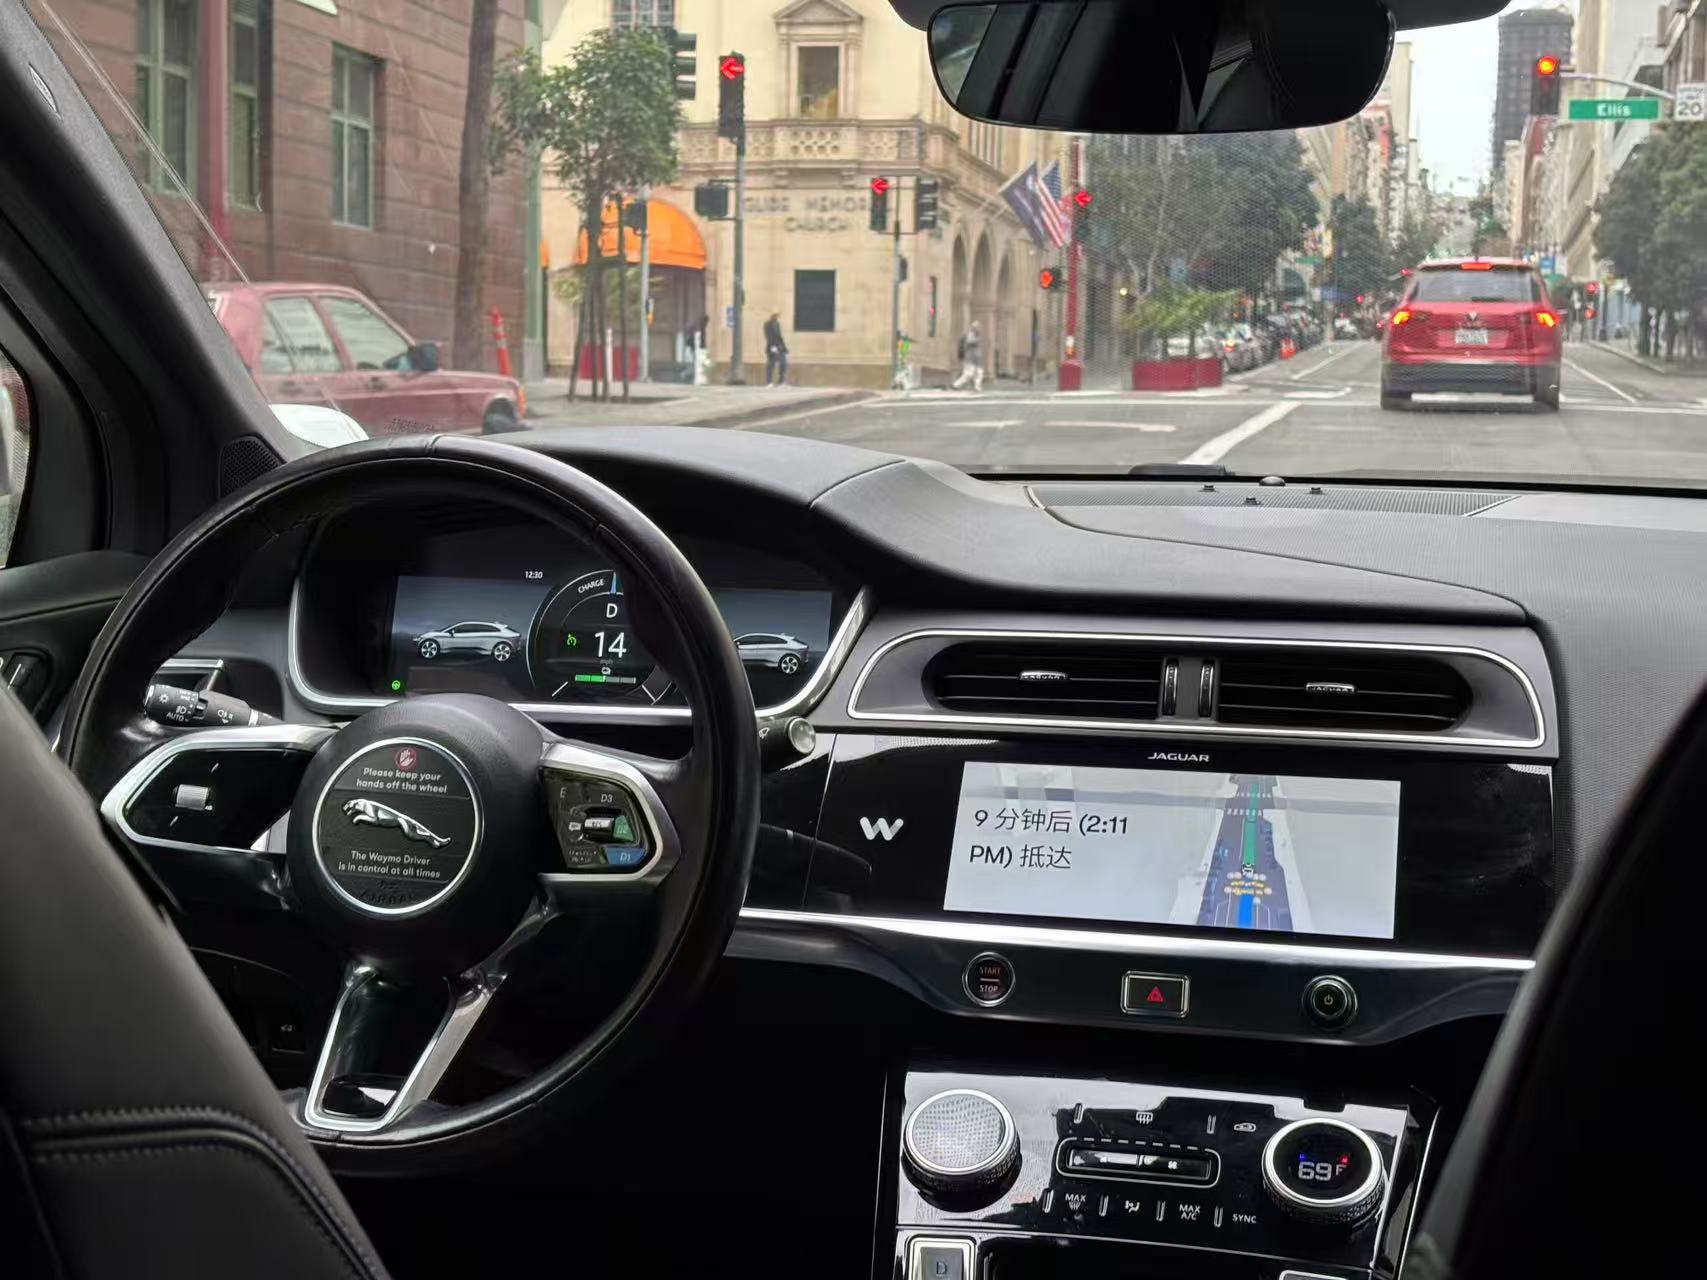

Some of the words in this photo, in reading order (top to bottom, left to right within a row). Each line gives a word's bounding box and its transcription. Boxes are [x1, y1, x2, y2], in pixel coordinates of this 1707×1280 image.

[1597, 103, 1631, 117] Ellis
[1678, 101, 1703, 116] 20
[525, 571, 543, 579] 12:30
[577, 578, 605, 593] CHARGE
[606, 603, 618, 618] D
[595, 631, 627, 659] 14
[166, 712, 185, 722] AUTO
[1147, 751, 1210, 763] JAGUAR
[363, 767, 394, 777] Please
[395, 770, 418, 780] keep
[419, 773, 441, 781] your
[356, 778, 384, 789] hands
[386, 780, 400, 789] off
[402, 782, 417, 791] the
[419, 783, 448, 793] wheel
[560, 787, 567, 798] E
[600, 794, 614, 803] D3
[975, 809, 989, 827] 9
[994, 807, 1073, 833] 分钟后
[1079, 815, 1128, 836] (2:11
[351, 850, 367, 860] The
[368, 852, 402, 864] Waymo
[403, 855, 430, 865] Driver
[620, 852, 631, 861] D1
[969, 844, 1013, 869] PM)
[1019, 844, 1073, 869] 抵达
[338, 861, 346, 870] is
[347, 862, 356, 871] in
[357, 864, 389, 874] control
[391, 866, 400, 874] at
[402, 867, 414, 876] all
[416, 868, 441, 878] times
[979, 966, 1001, 975] START
[979, 984, 999, 993] STOP
[1065, 1193, 1086, 1203] MAX
[1179, 1203, 1201, 1214] MAX
[1180, 1211, 1197, 1221] A/C
[1232, 1213, 1257, 1224] SYNC
[936, 1261, 948, 1275] D
